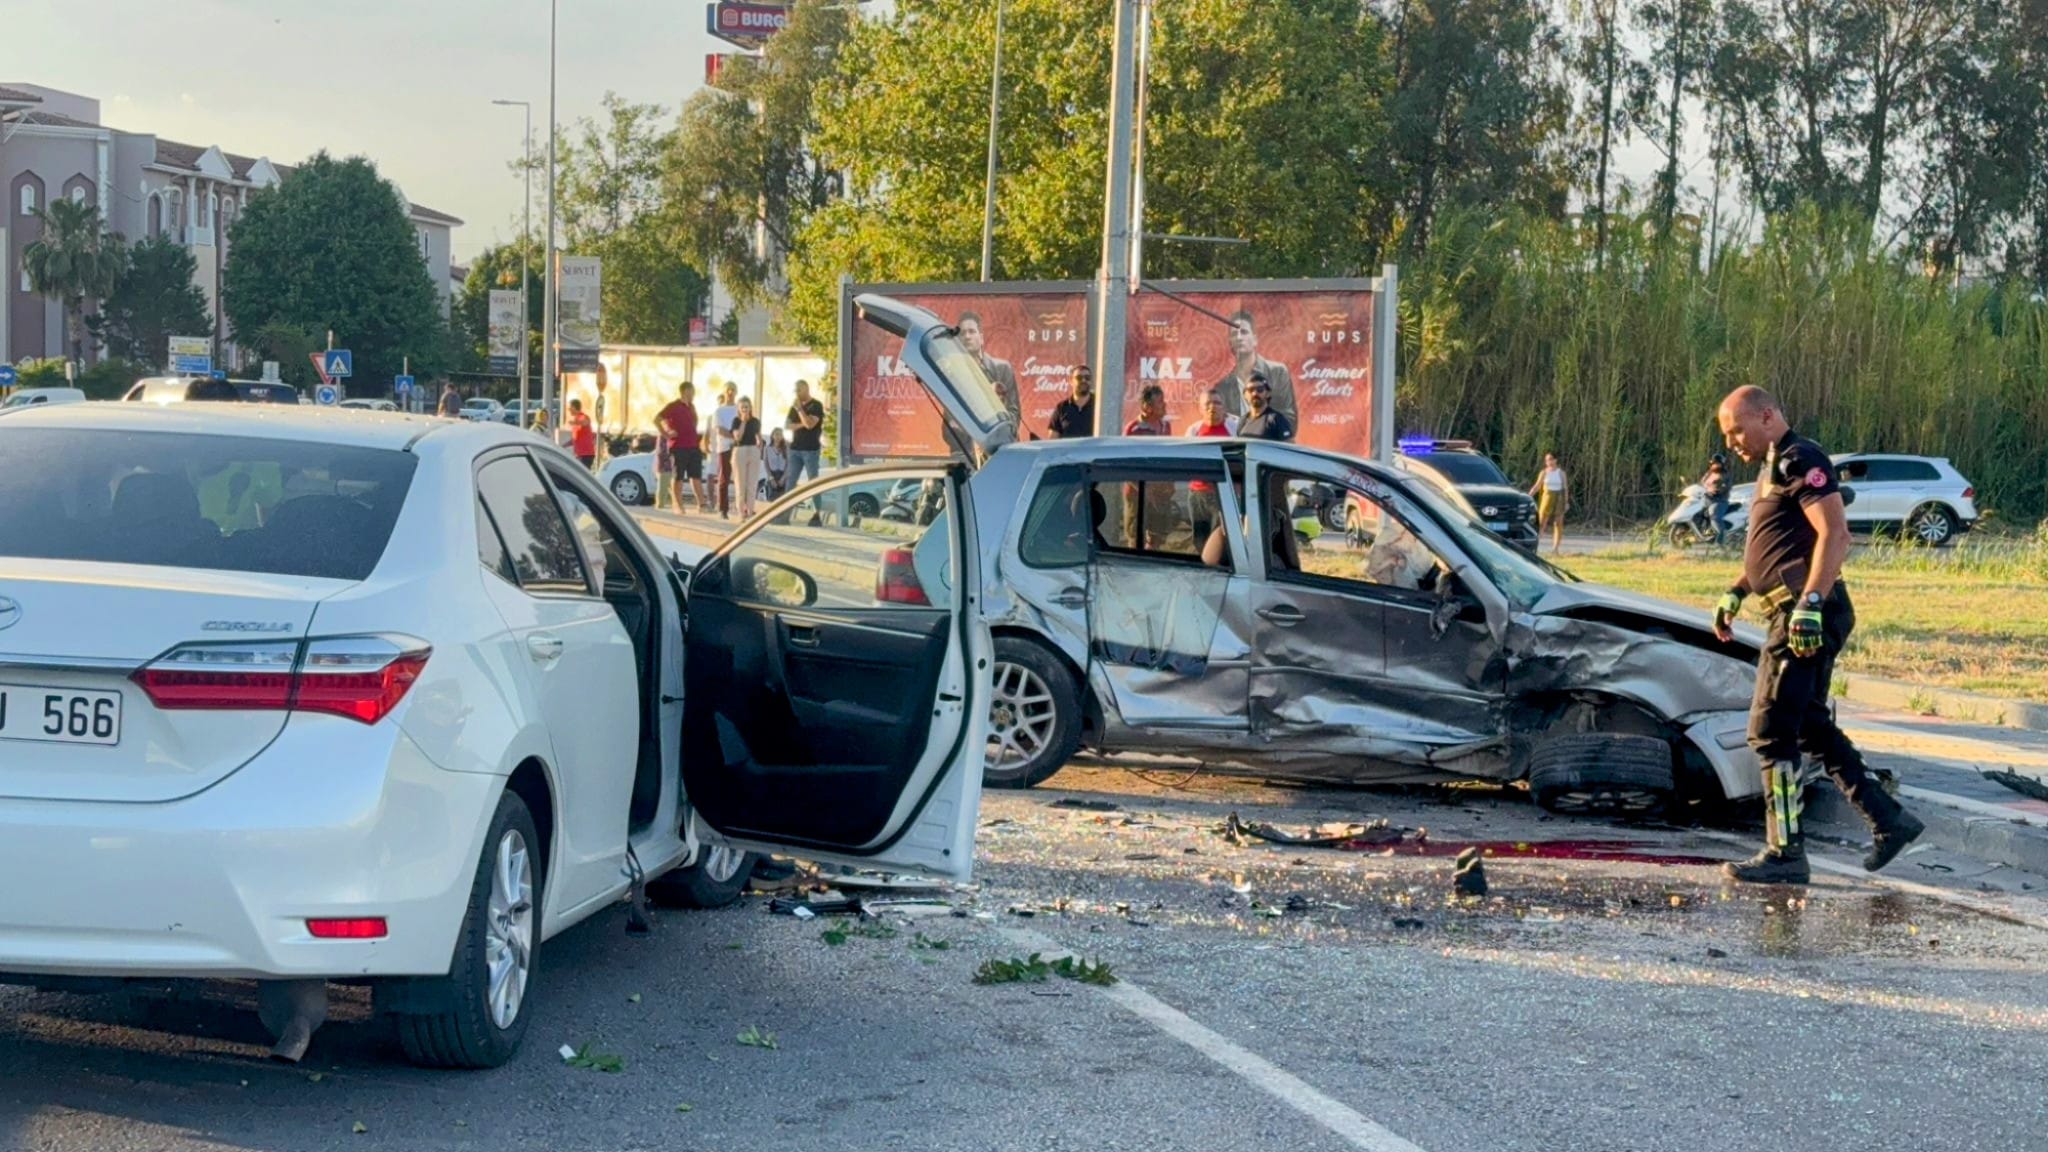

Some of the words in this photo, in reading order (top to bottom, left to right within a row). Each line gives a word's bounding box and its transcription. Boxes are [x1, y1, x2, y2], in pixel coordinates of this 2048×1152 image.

[741, 11, 785, 27] BURG
[1028, 329, 1077, 342] RUPS
[1146, 326, 1179, 337] RUPS
[1306, 330, 1361, 344] RUPS
[877, 355, 913, 376] KA
[1020, 356, 1073, 376] Summe
[1139, 357, 1193, 379] KAZ
[1299, 358, 1367, 380] Summer
[864, 376, 927, 399] JAME
[1033, 375, 1069, 393] Starts
[1311, 379, 1354, 397] Starts
[1311, 413, 1337, 425] JUNE
[201, 620, 293, 632] COROLLA
[44, 695, 115, 738] 566
